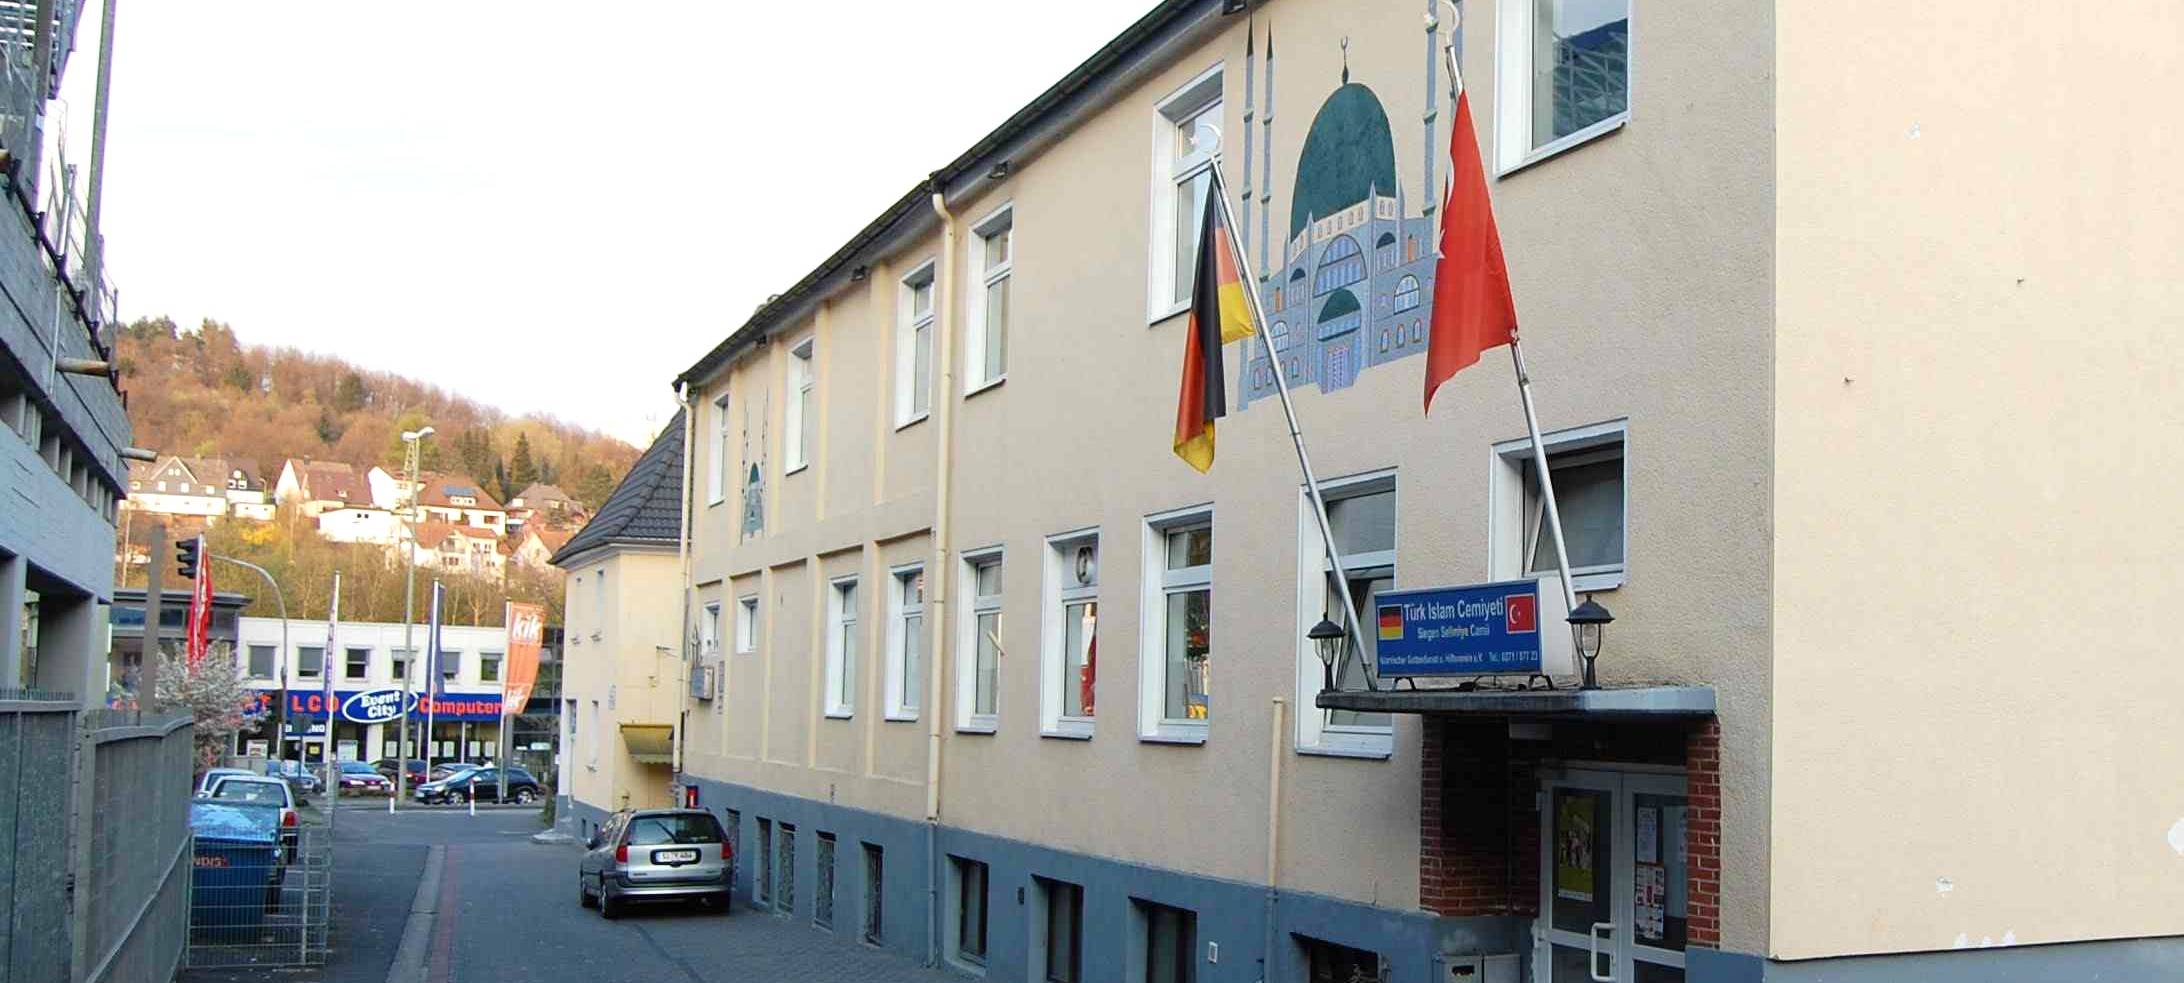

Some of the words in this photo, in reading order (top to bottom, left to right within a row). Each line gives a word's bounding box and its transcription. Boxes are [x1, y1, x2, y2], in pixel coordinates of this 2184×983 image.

[1403, 603, 1426, 621] Türk
[1428, 601, 1455, 620] Islam
[1457, 597, 1504, 621] Cemiyeti
[512, 611, 542, 641] kik
[361, 691, 400, 707] Event
[418, 694, 503, 716] Computer
[368, 704, 397, 718] City
